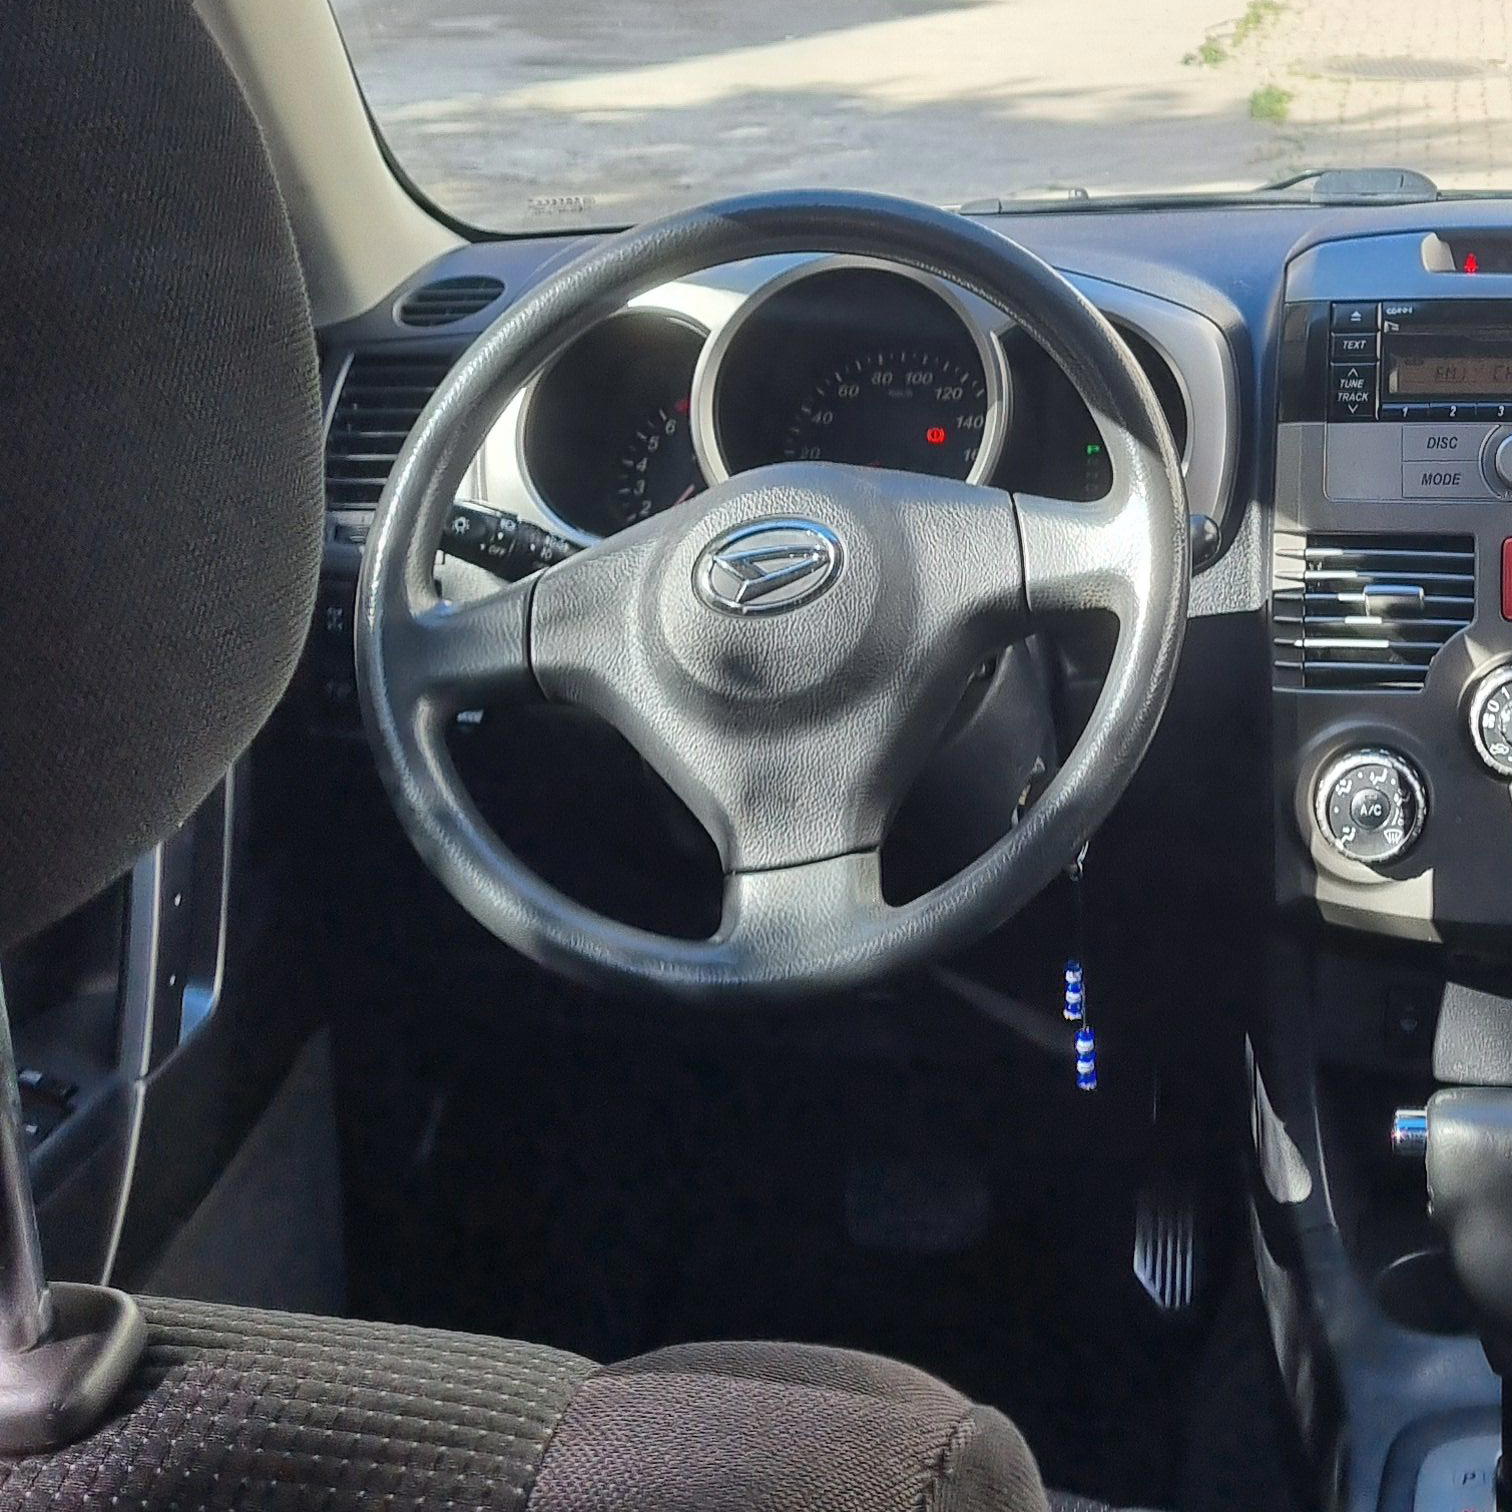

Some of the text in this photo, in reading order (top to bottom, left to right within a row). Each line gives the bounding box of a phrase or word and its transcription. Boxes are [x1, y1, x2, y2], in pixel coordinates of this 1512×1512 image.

[1342, 340, 1366, 349] TEXT
[906, 372, 933, 385] 100
[1340, 379, 1365, 389] TUNE
[935, 387, 963, 400] 120
[1337, 392, 1369, 402] TRACK
[1402, 407, 1409, 418] 1
[1450, 405, 1457, 417] 2
[1497, 405, 1505, 417] 3
[811, 411, 833, 425] 40
[956, 415, 984, 429] 140
[665, 419, 677, 435] 6
[1427, 437, 1458, 449] DISC
[1421, 473, 1462, 486] MODE
[1501, 686, 1510, 700] 1
[1360, 803, 1382, 816] A/C
[1462, 1472, 1476, 1486] P
